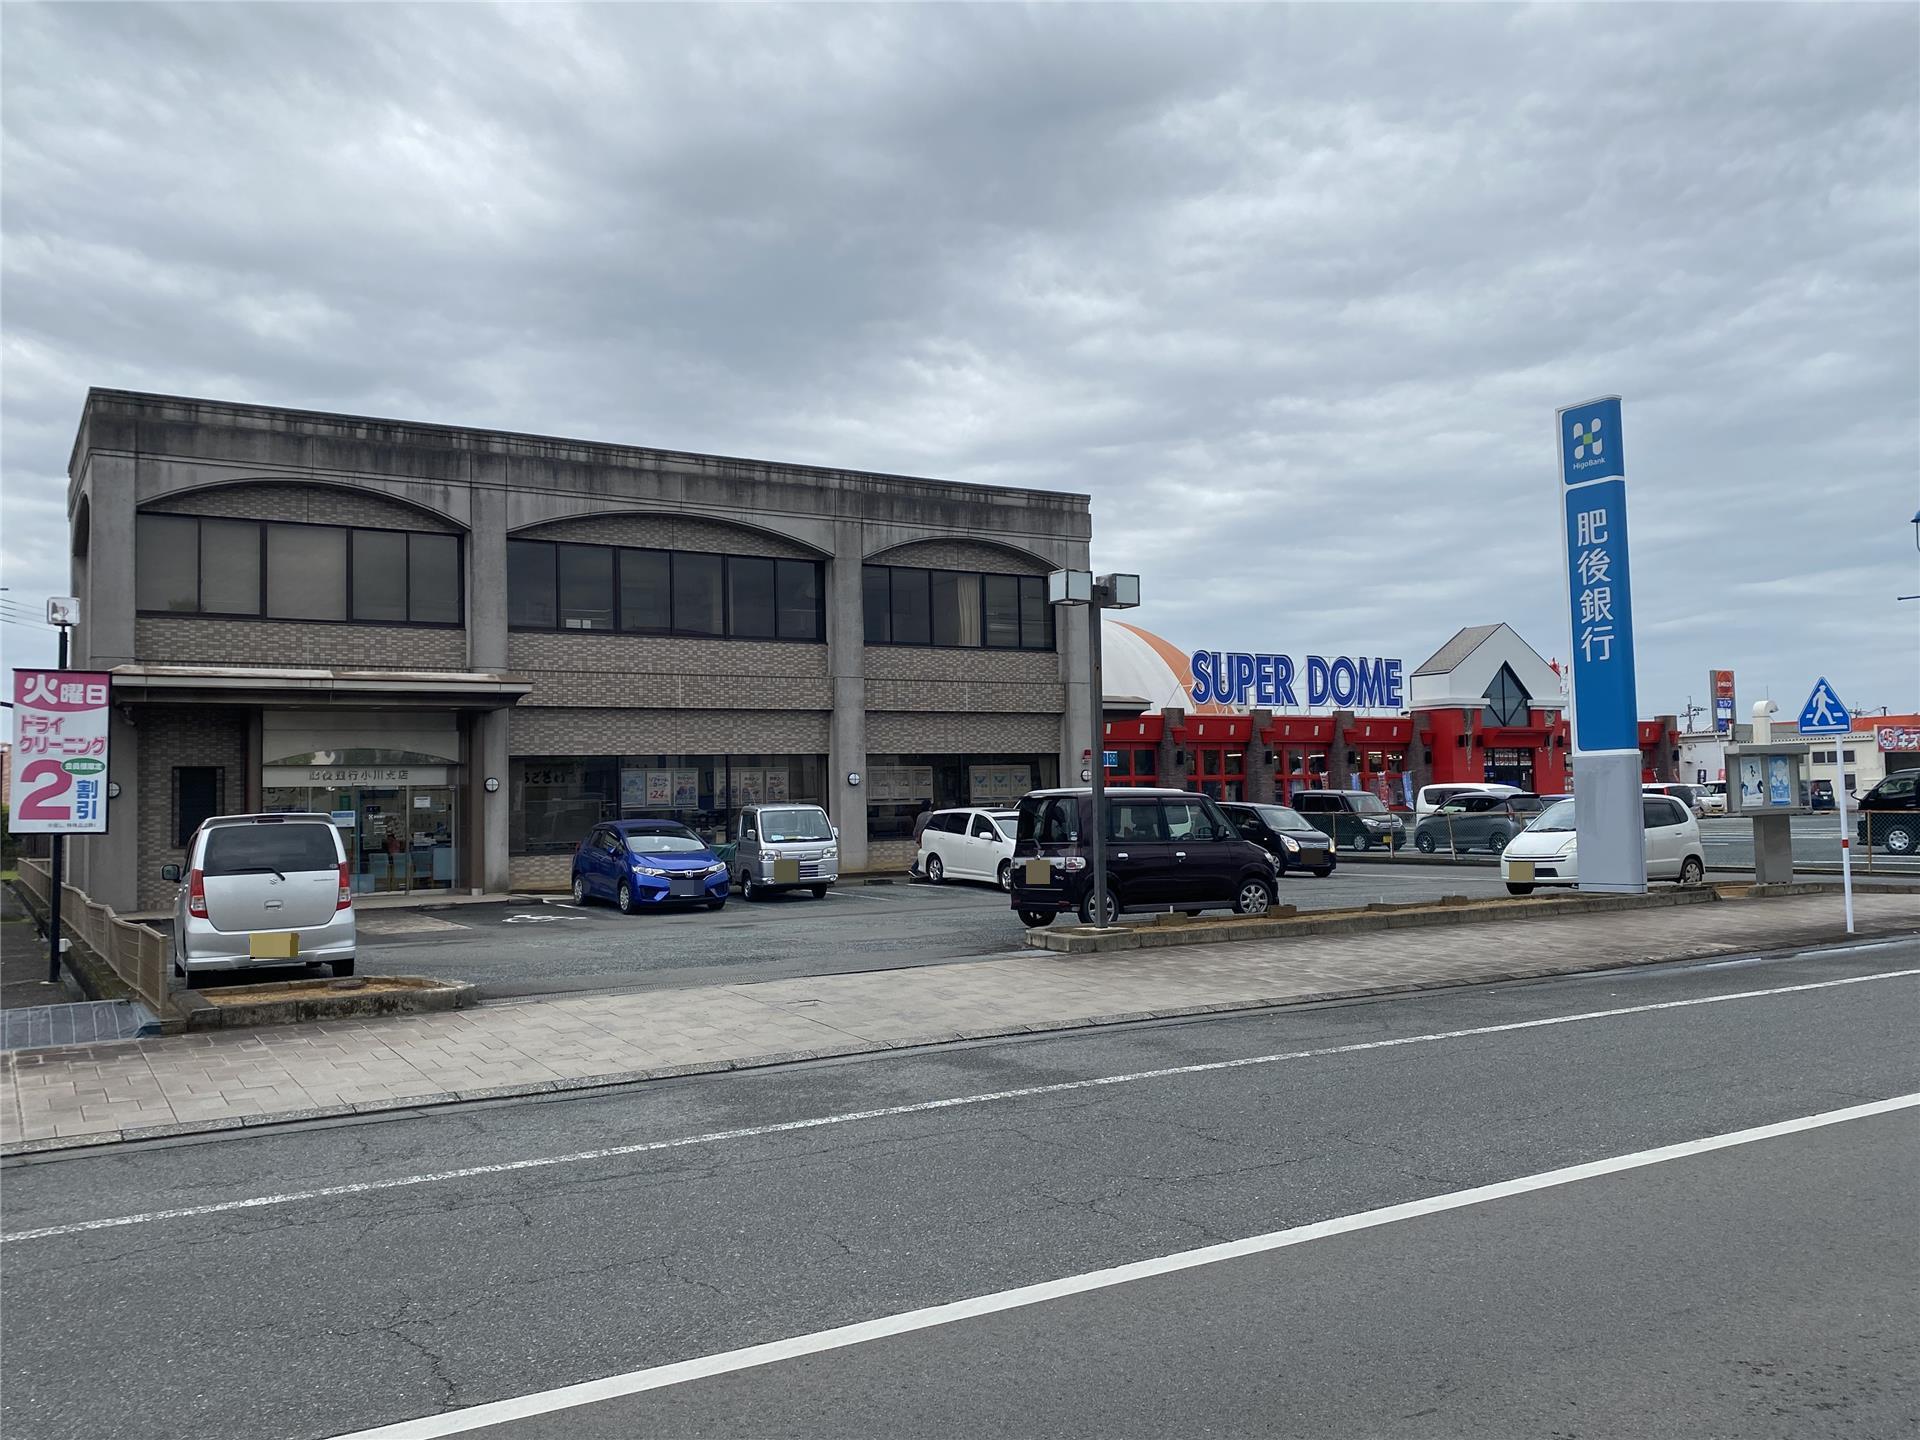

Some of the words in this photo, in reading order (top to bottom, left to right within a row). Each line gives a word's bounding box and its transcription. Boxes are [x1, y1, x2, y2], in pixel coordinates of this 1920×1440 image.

[1573, 457, 1606, 471] HigoBank
[1577, 508, 1615, 663] 肥後銀行
[23, 673, 107, 705] 火曜日
[1190, 649, 1299, 707] SUPER
[1305, 654, 1404, 709] DOME
[20, 714, 65, 734] ドライ
[20, 736, 106, 755] クリーニング
[18, 759, 73, 820] 2
[76, 779, 99, 820] 割引
